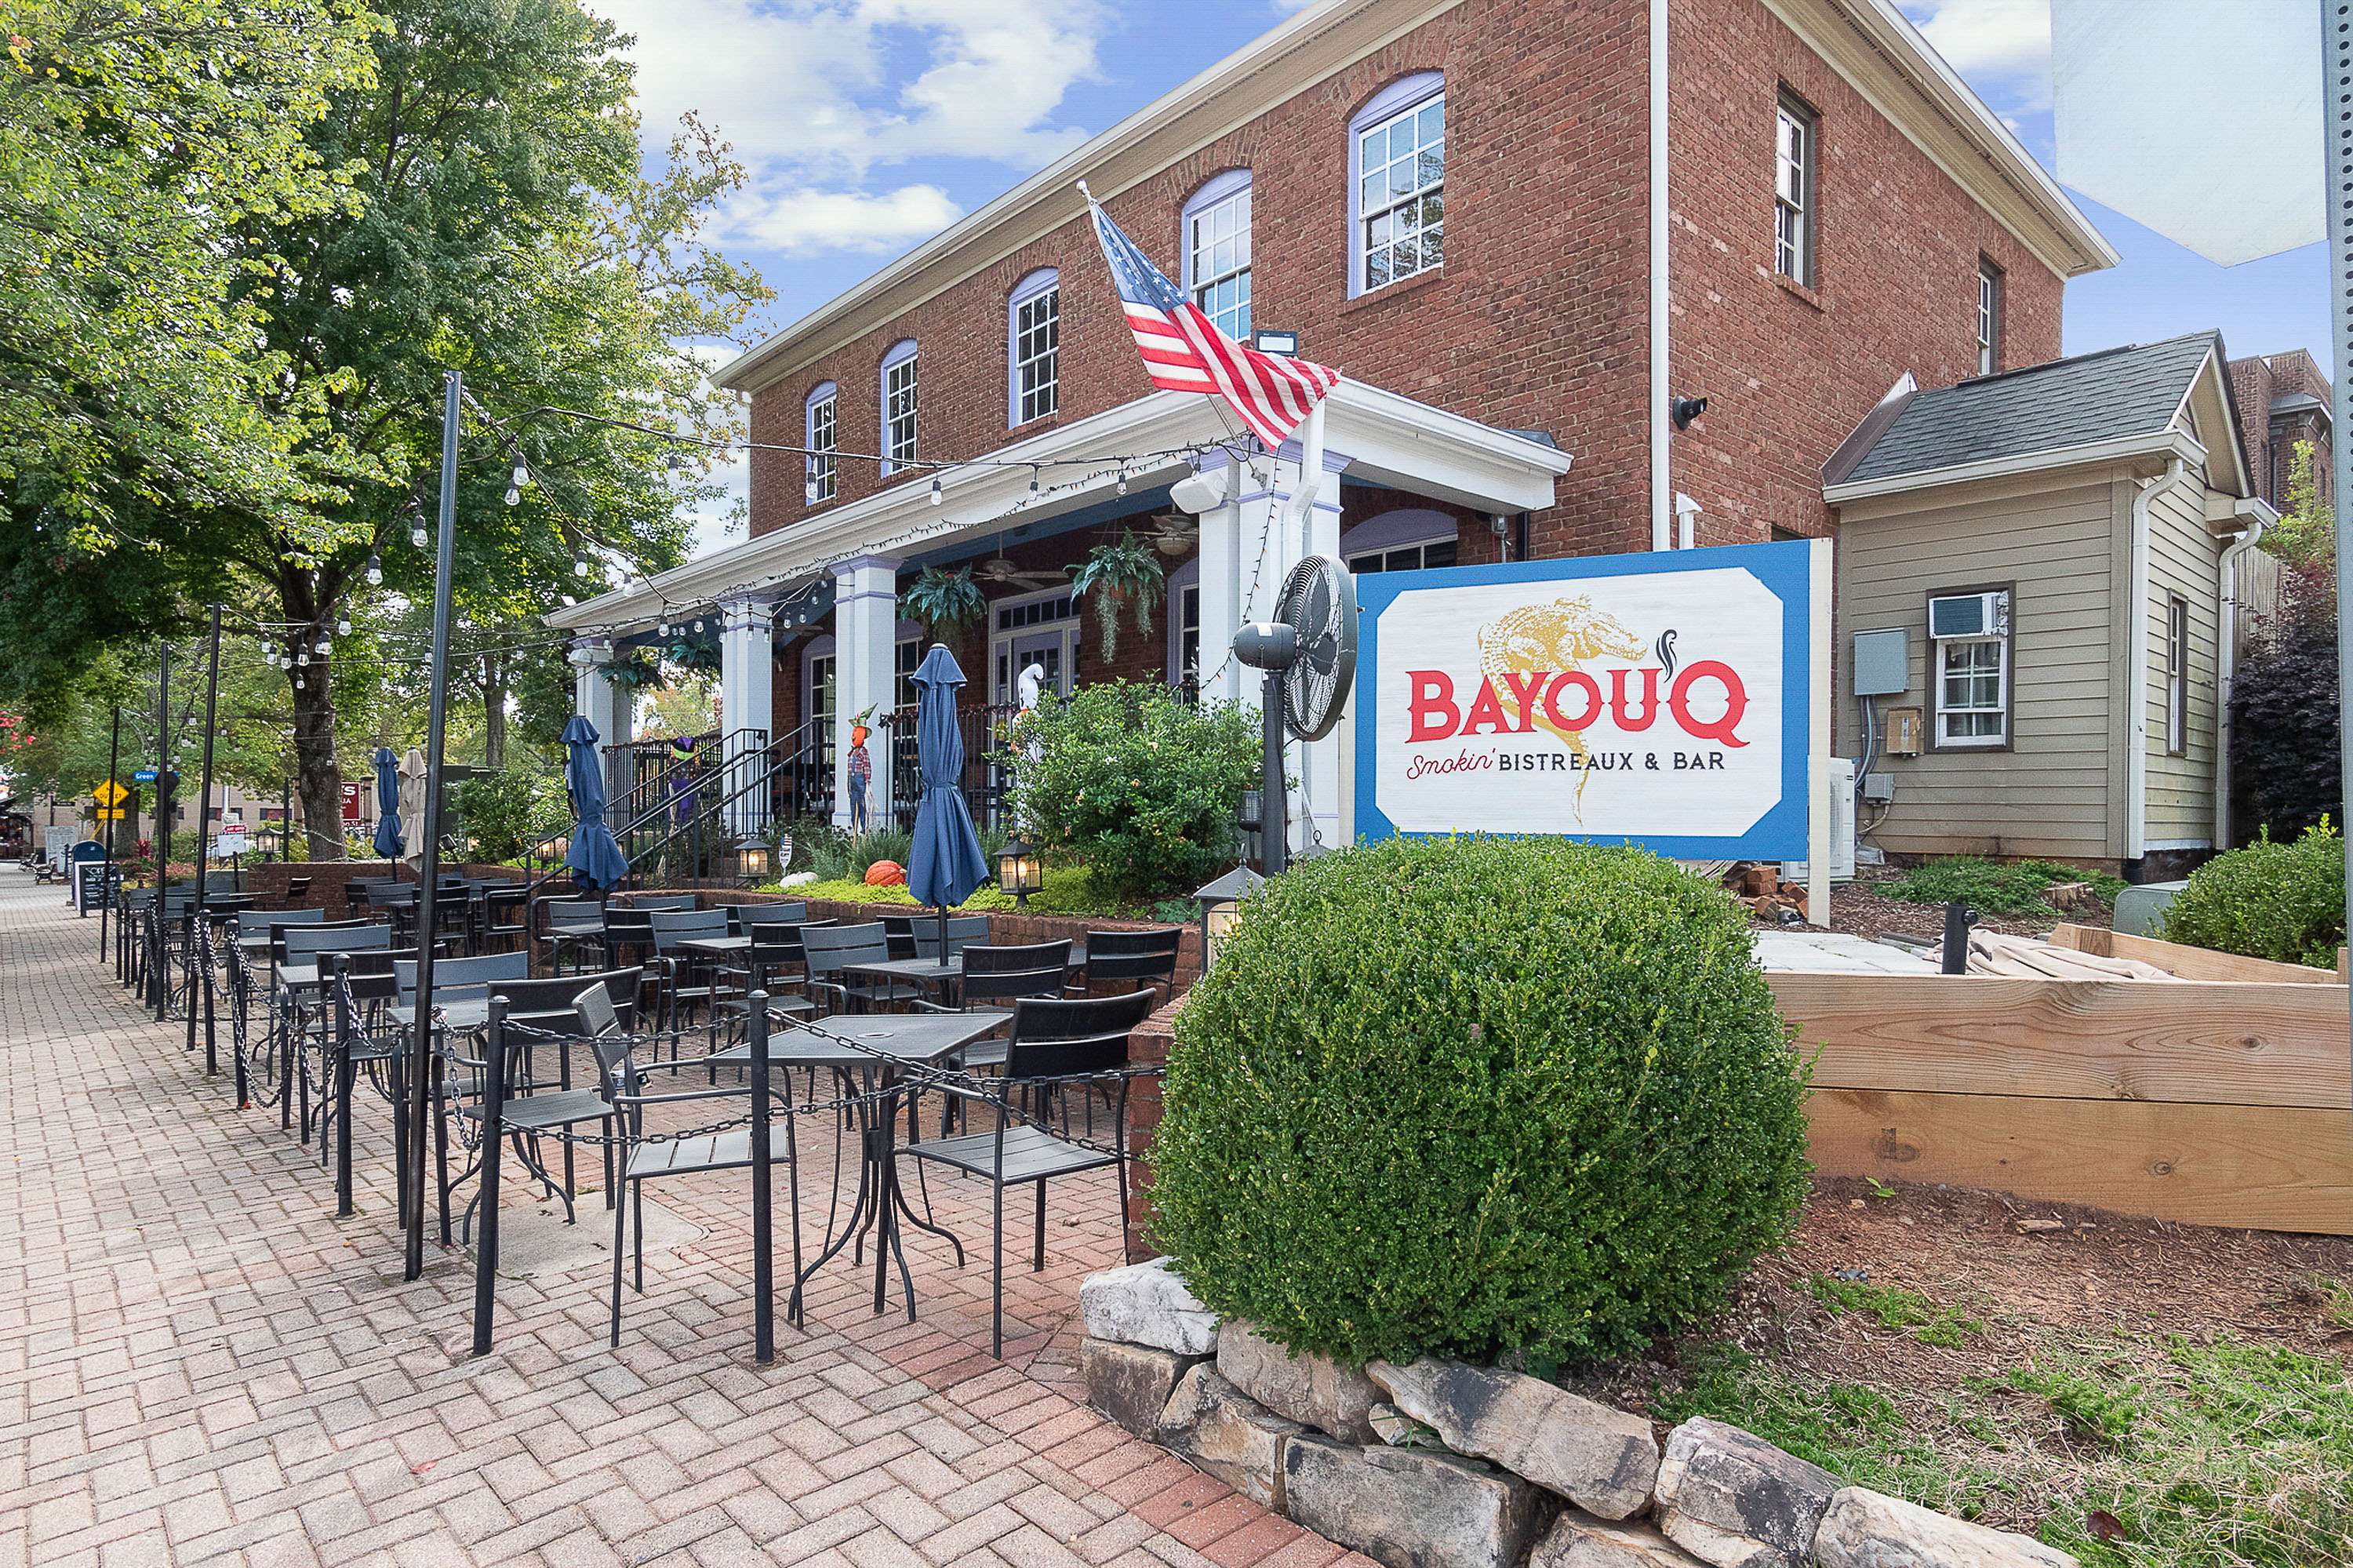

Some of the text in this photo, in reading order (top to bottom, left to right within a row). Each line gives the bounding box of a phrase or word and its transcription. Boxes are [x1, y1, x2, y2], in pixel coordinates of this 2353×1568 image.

[1406, 748, 1726, 780] Smokin' BISTREAUX & BAR
